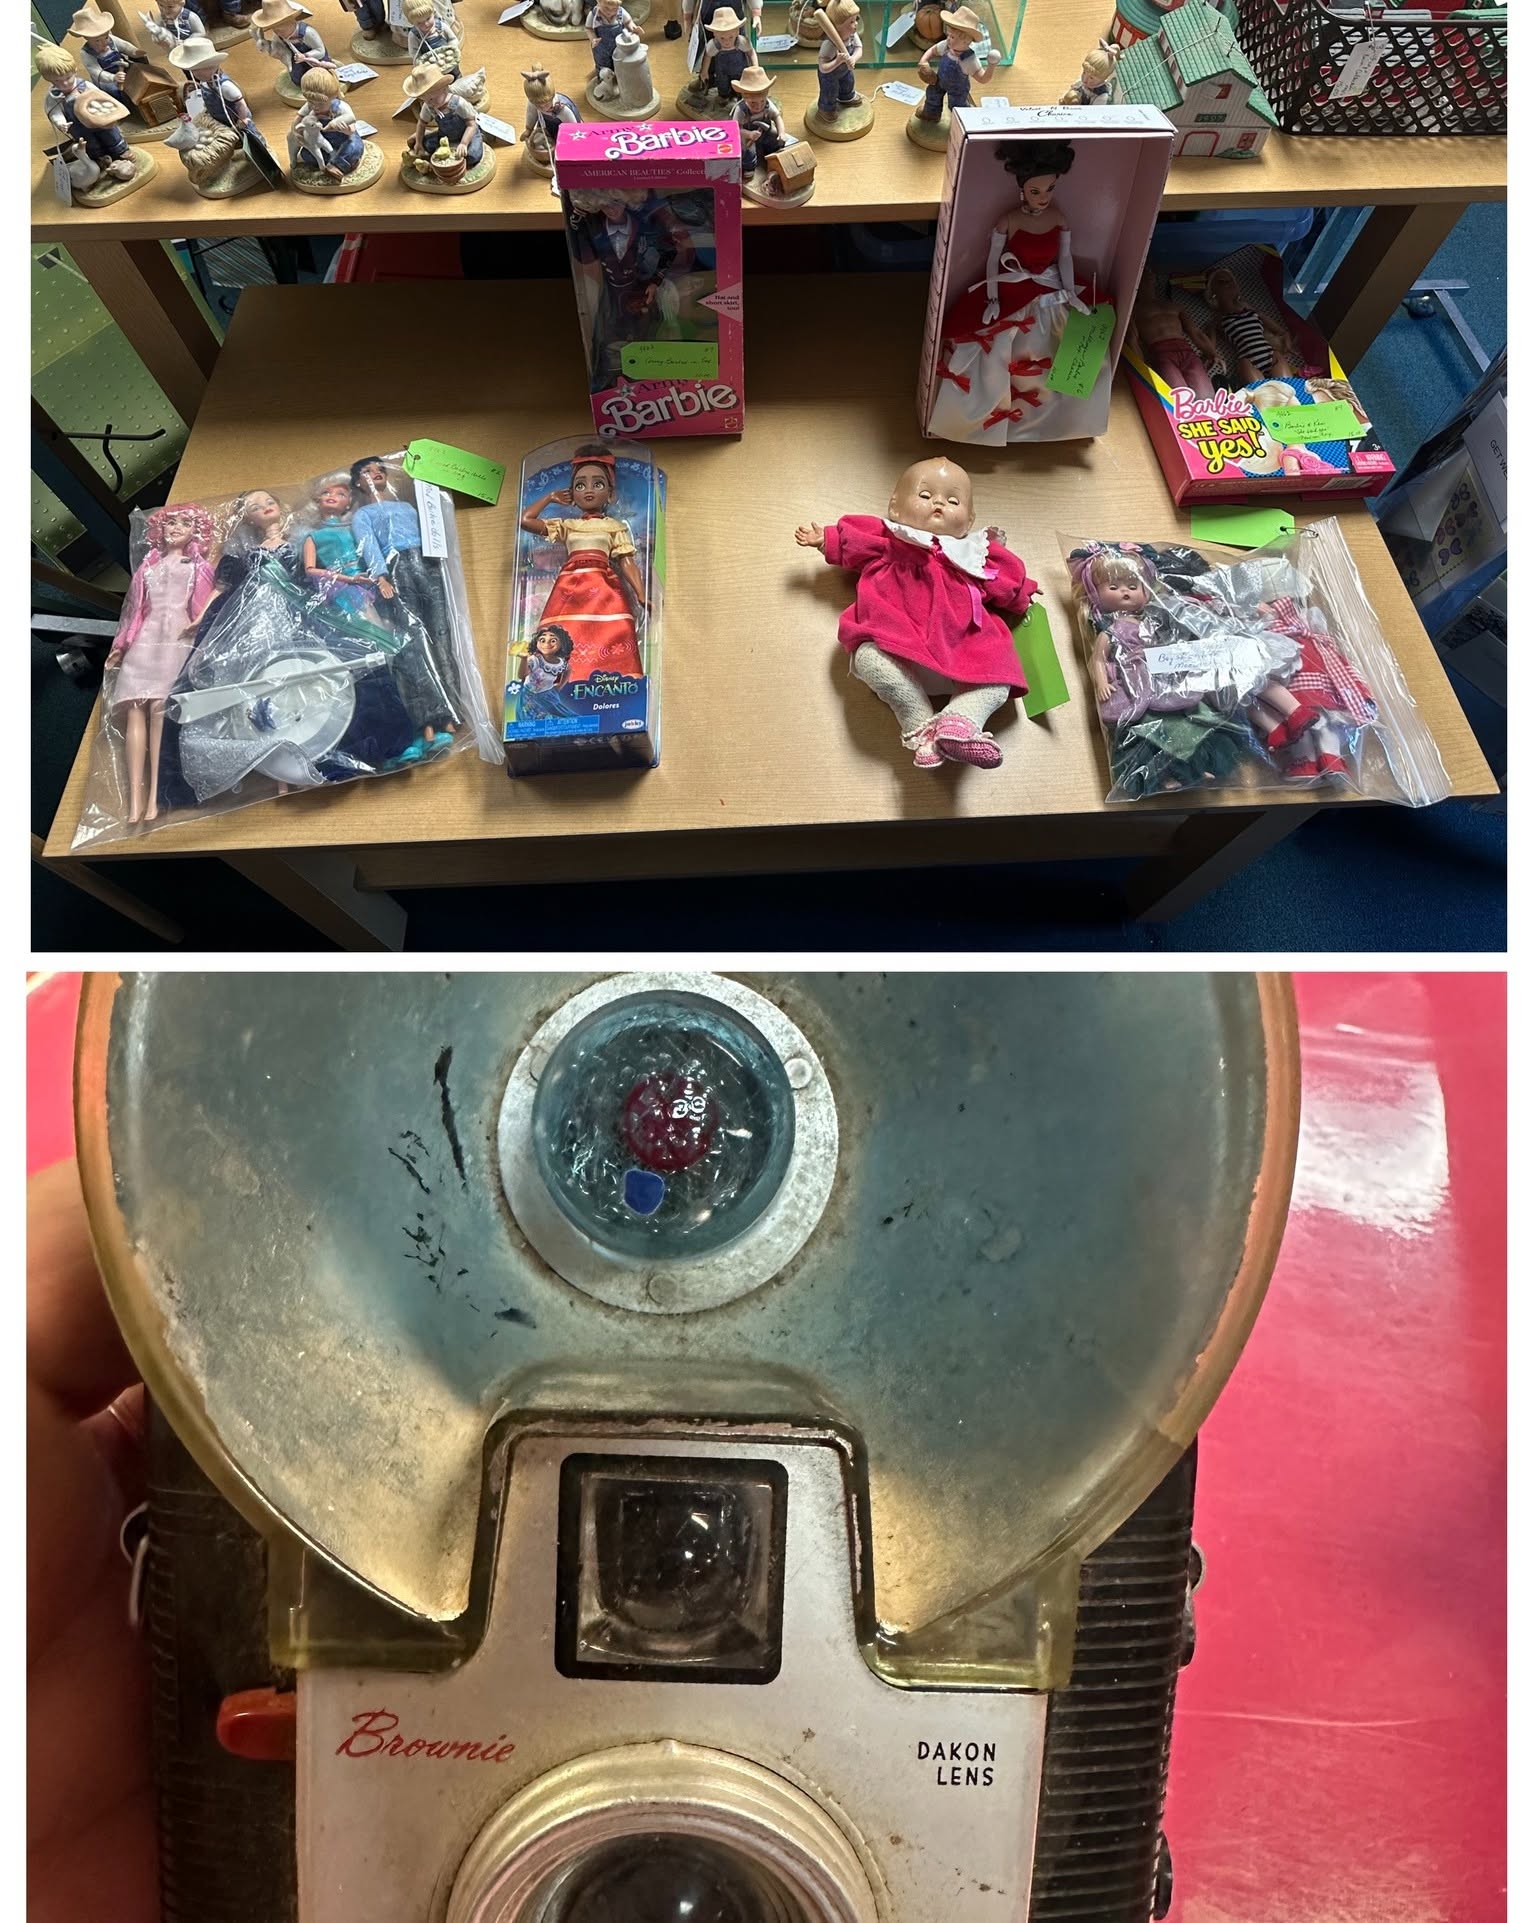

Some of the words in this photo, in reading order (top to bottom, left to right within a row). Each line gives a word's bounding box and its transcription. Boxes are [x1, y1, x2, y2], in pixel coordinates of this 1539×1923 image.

[605, 126, 728, 159] Barbie
[583, 168, 628, 177] AMERICAN
[599, 383, 737, 438] Barbie
[1171, 388, 1252, 420] Barbie
[1178, 420, 1216, 439] SHE
[1217, 417, 1262, 434] SAID
[1198, 430, 1267, 473] yes!
[1490, 439, 1503, 459] GET
[593, 674, 620, 683] Disney
[574, 682, 639, 699] ENCANTO
[593, 702, 620, 711] Dolores
[335, 1710, 518, 1764] Brownie
[917, 1741, 997, 1762] DAKON
[936, 1766, 995, 1787] LENS
